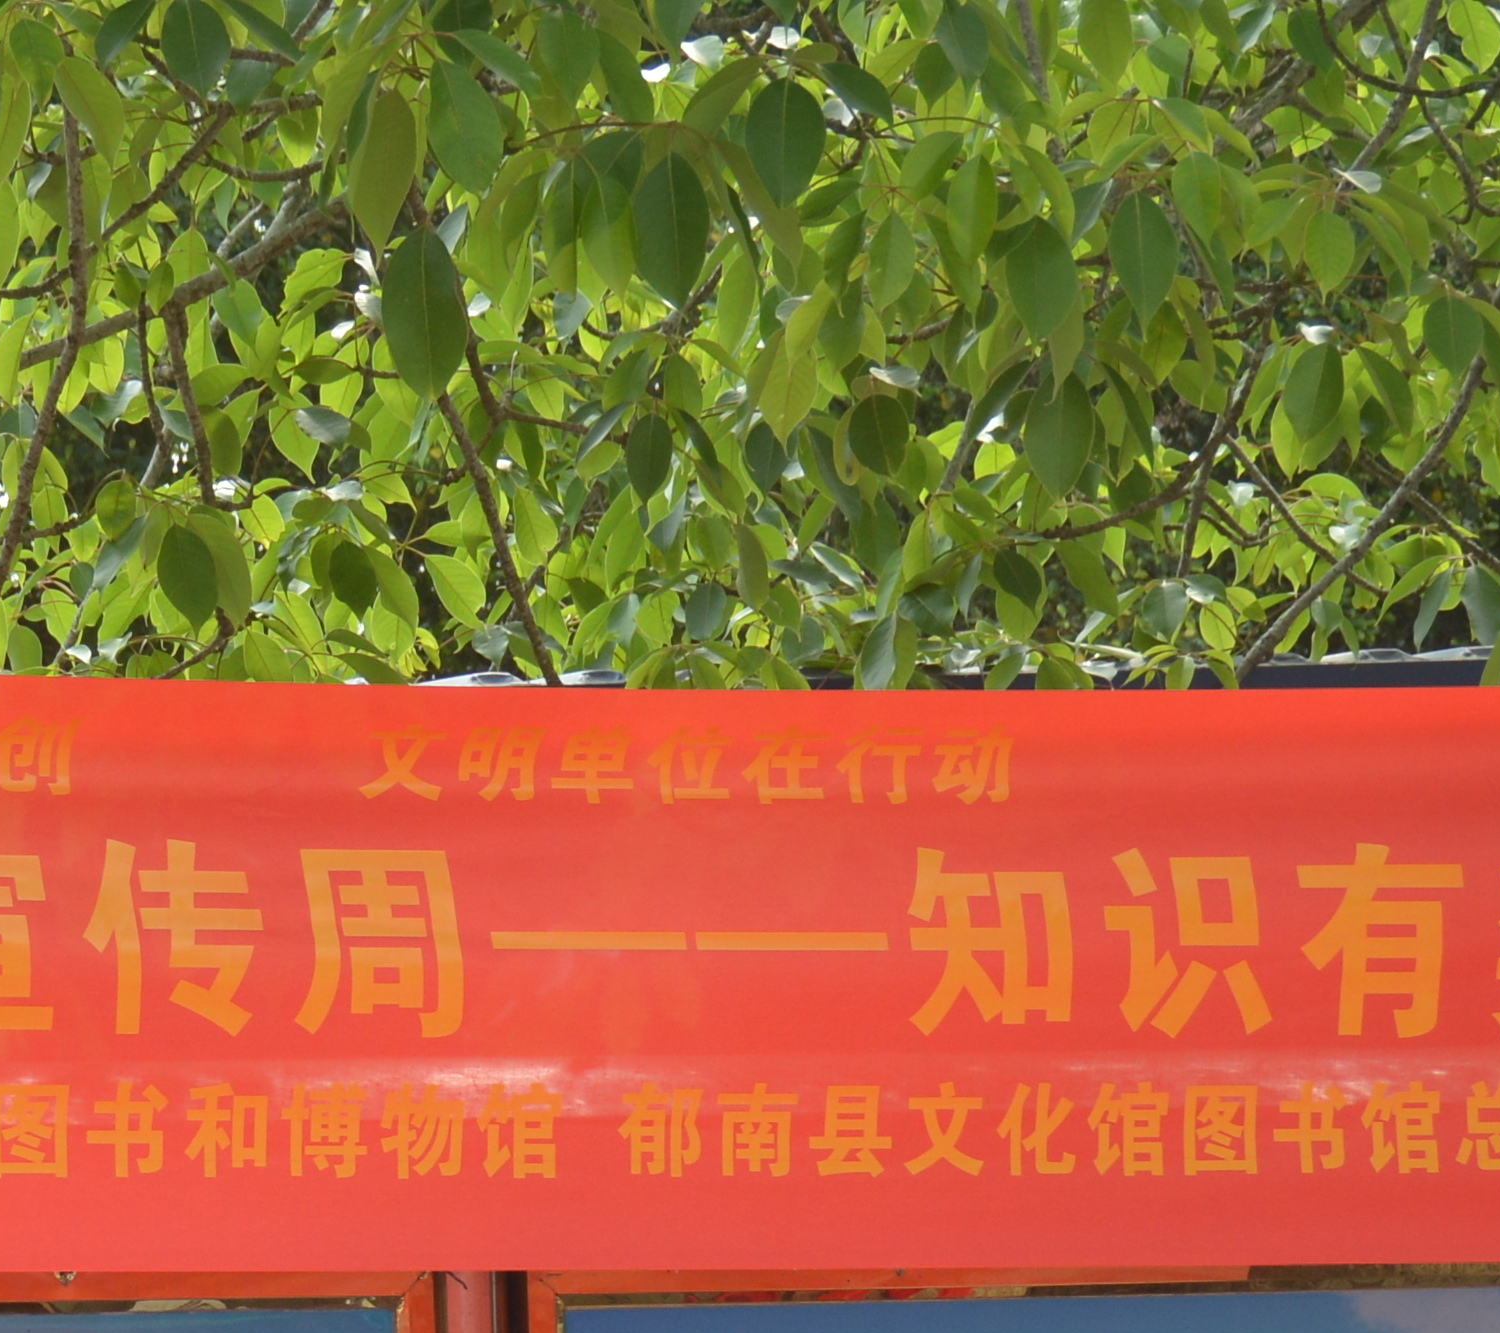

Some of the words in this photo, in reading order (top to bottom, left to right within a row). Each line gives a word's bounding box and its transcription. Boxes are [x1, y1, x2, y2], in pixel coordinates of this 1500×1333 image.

[359, 722, 1014, 806] 文明单位在行动
